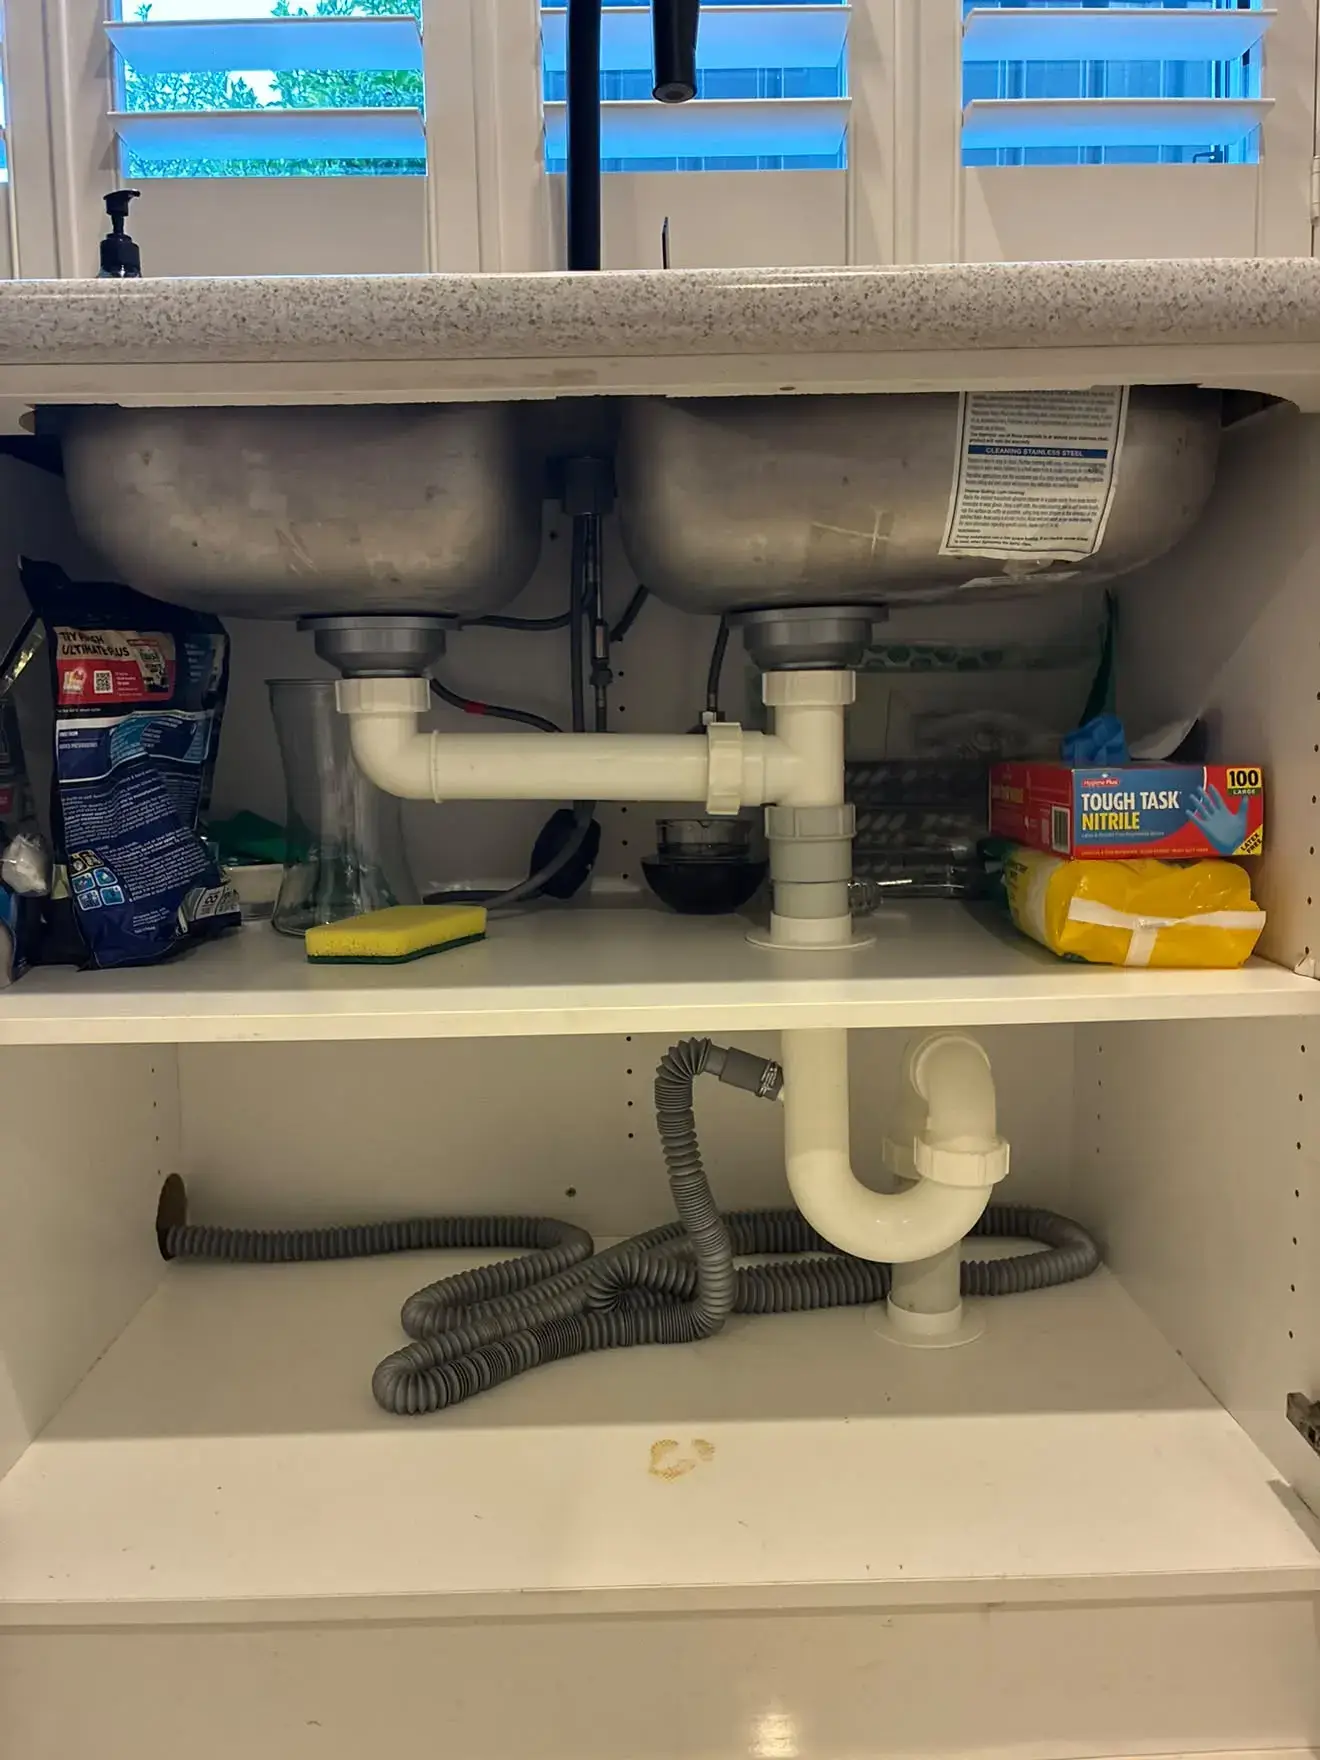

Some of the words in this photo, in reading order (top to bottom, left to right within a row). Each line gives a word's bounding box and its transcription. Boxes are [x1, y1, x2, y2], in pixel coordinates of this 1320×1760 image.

[985, 447, 1021, 455] CLEANING
[1022, 448, 1061, 456] STAINLESS
[1229, 769, 1259, 787] 100
[1081, 791, 1135, 812] TOUGH
[1140, 790, 1181, 810] TASK
[1081, 811, 1140, 831] NITRILE
[1240, 832, 1261, 852] LATEX
[1246, 837, 1262, 854] FREE
